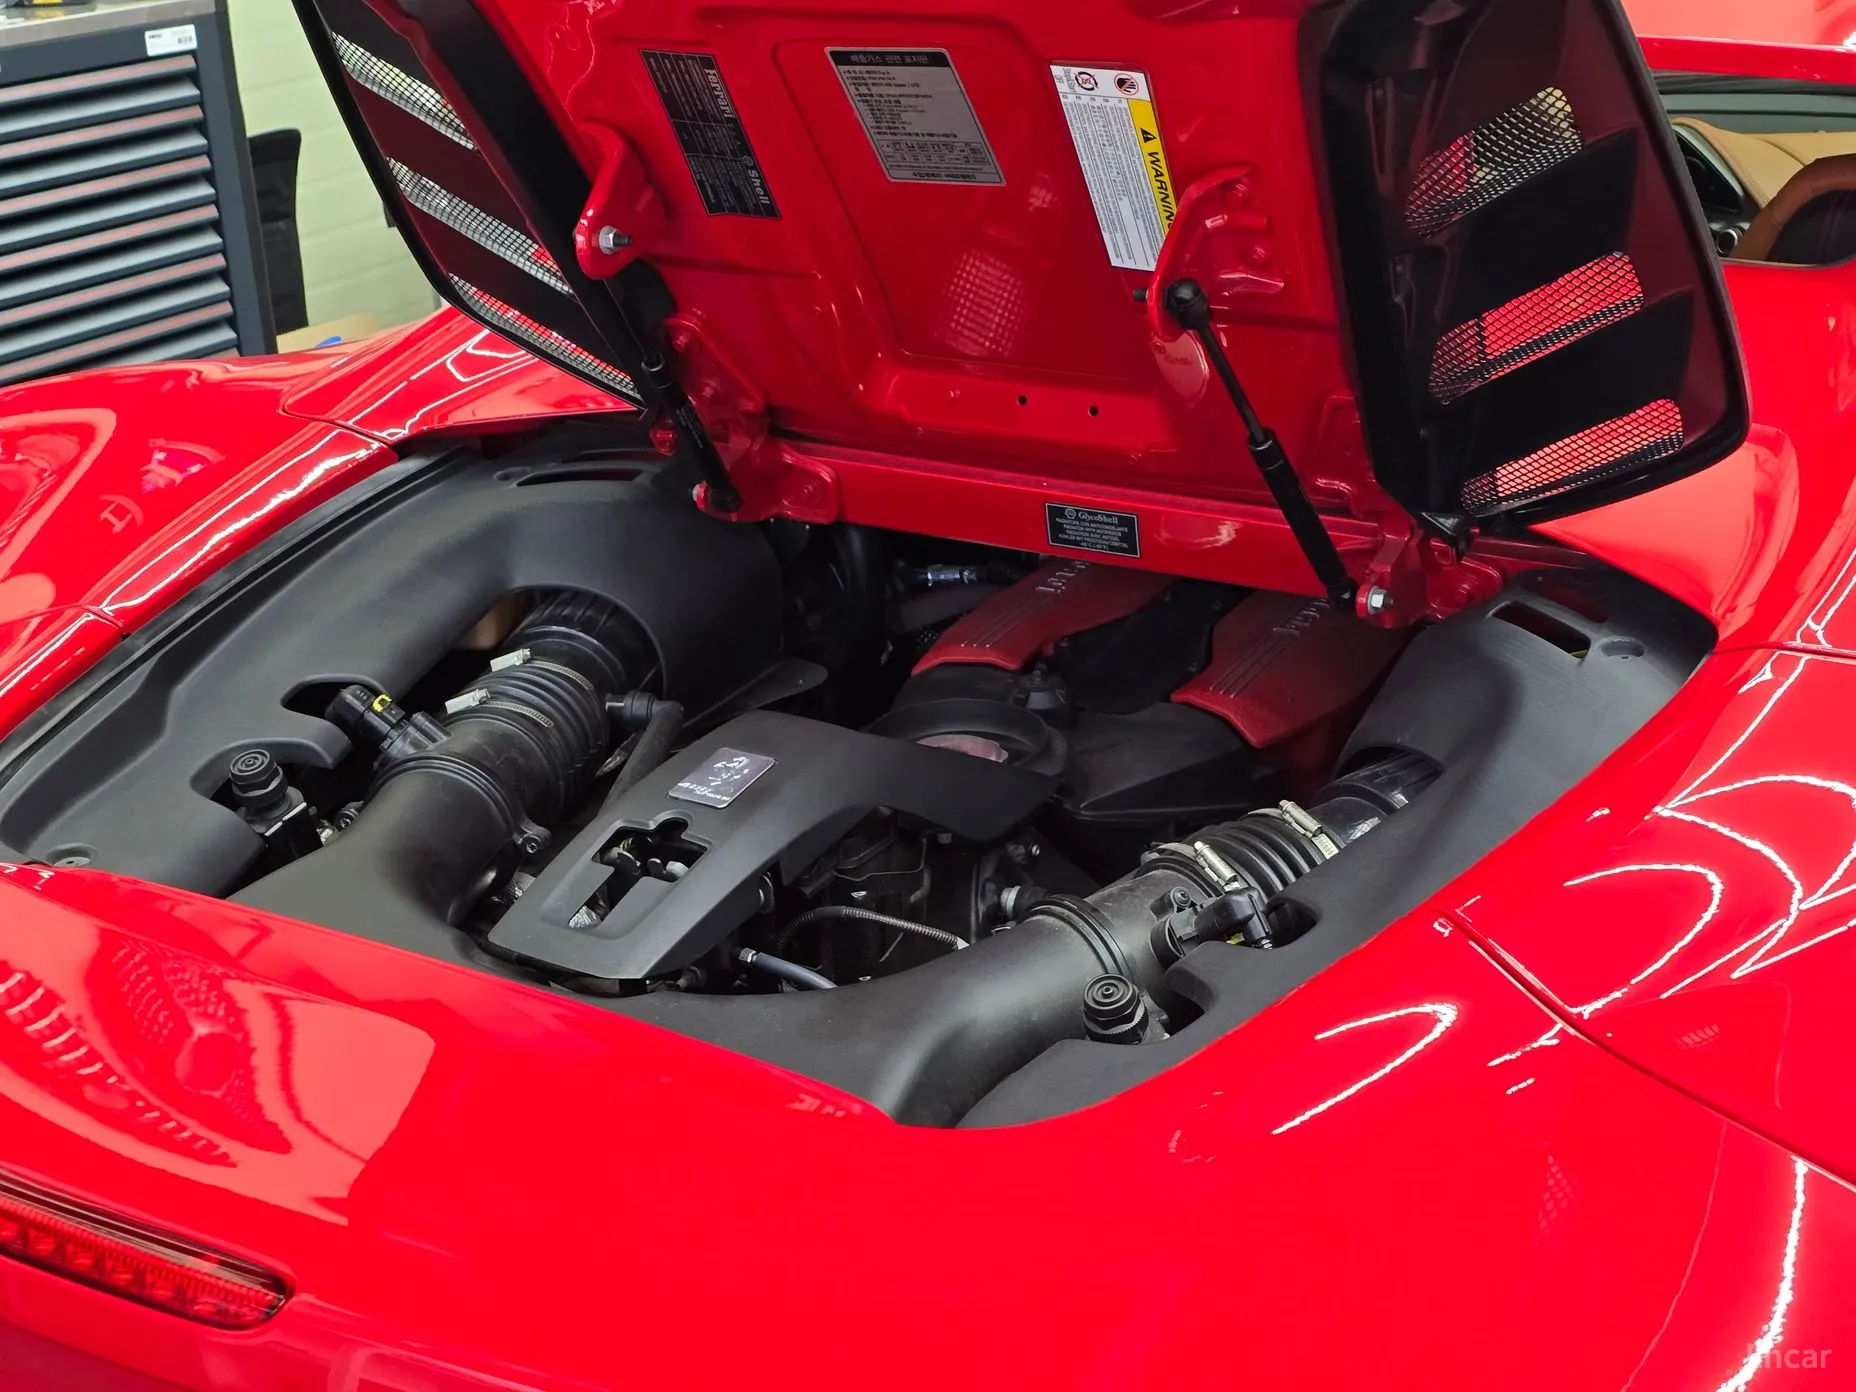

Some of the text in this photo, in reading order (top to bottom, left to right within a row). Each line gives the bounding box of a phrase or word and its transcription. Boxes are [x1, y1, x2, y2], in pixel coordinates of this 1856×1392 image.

[704, 68, 735, 119] Ferrari
[748, 169, 771, 205] Shell
[1078, 511, 1118, 524] GlycoShell
